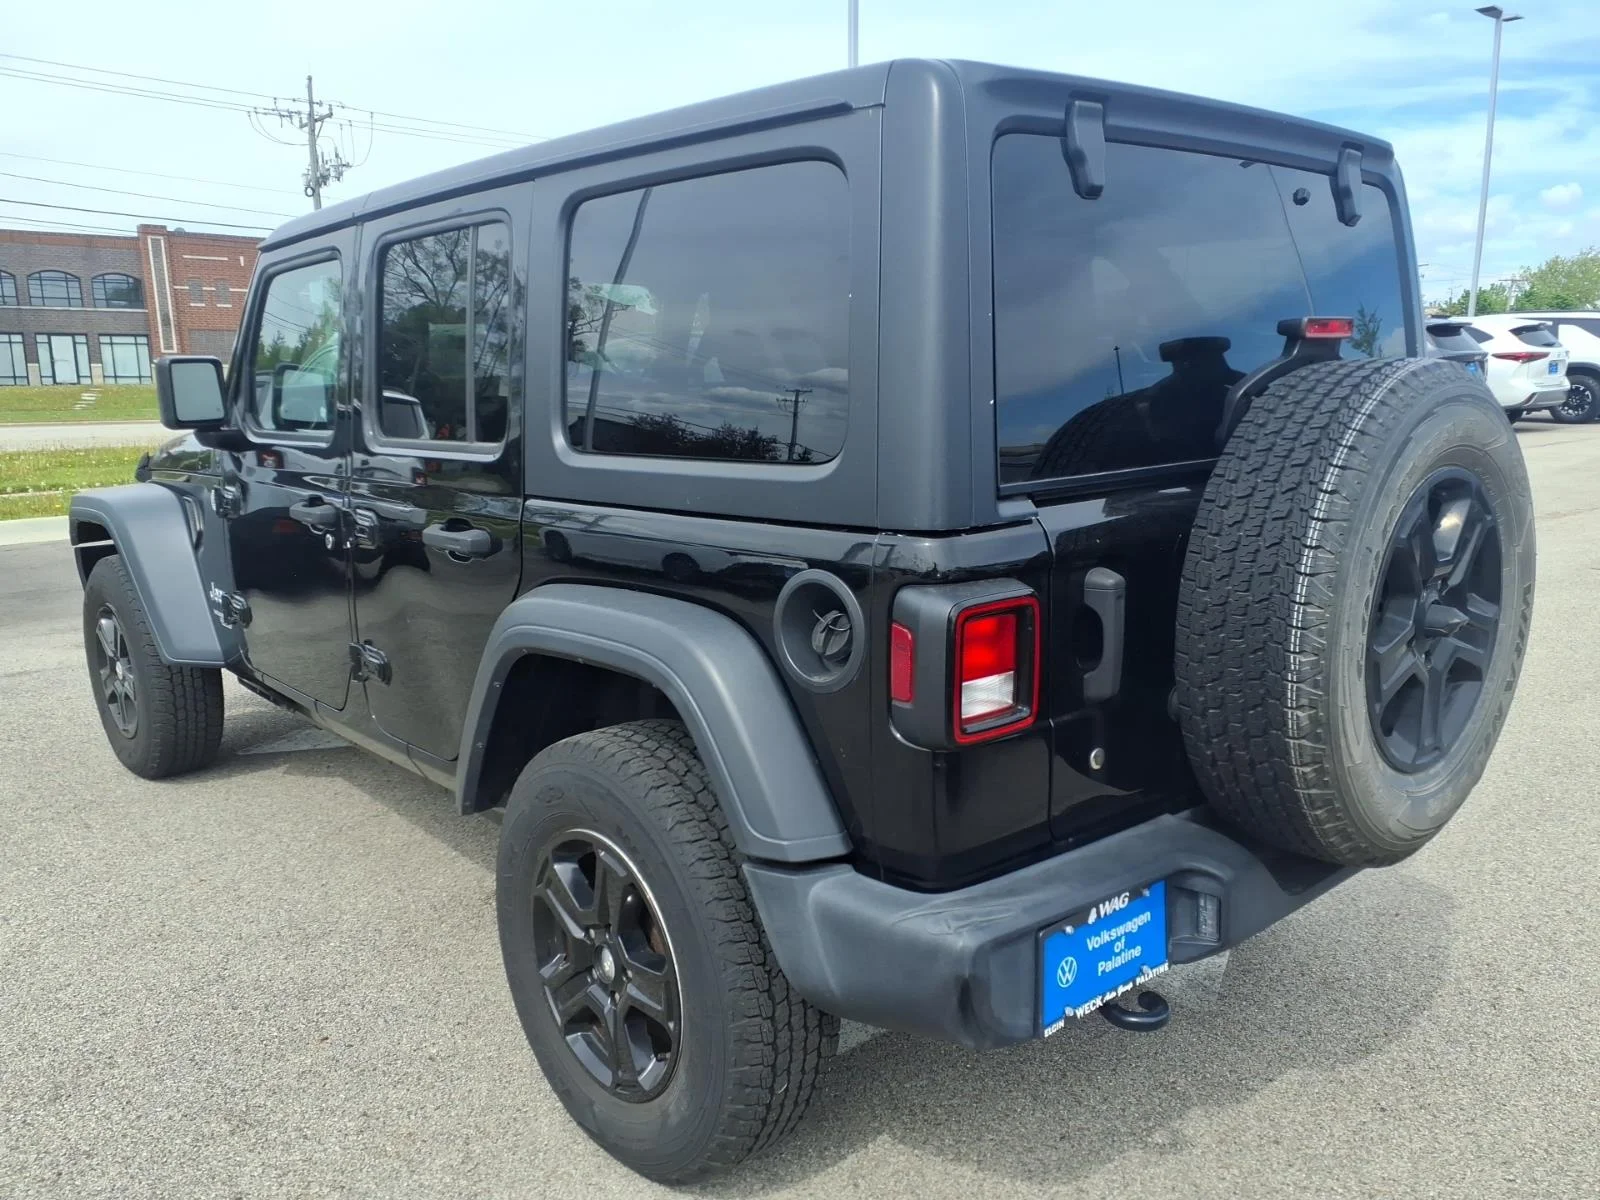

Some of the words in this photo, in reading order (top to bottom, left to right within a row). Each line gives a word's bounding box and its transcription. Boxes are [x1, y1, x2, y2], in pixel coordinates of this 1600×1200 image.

[1099, 892, 1130, 918] WAG
[1086, 911, 1151, 951] Volkswagen
[1114, 936, 1126, 953] of
[1098, 945, 1142, 976] Palatine
[1044, 1019, 1065, 1038] ELGIN
[1075, 995, 1103, 1019] WECK
[1136, 962, 1169, 986] PALATINE
